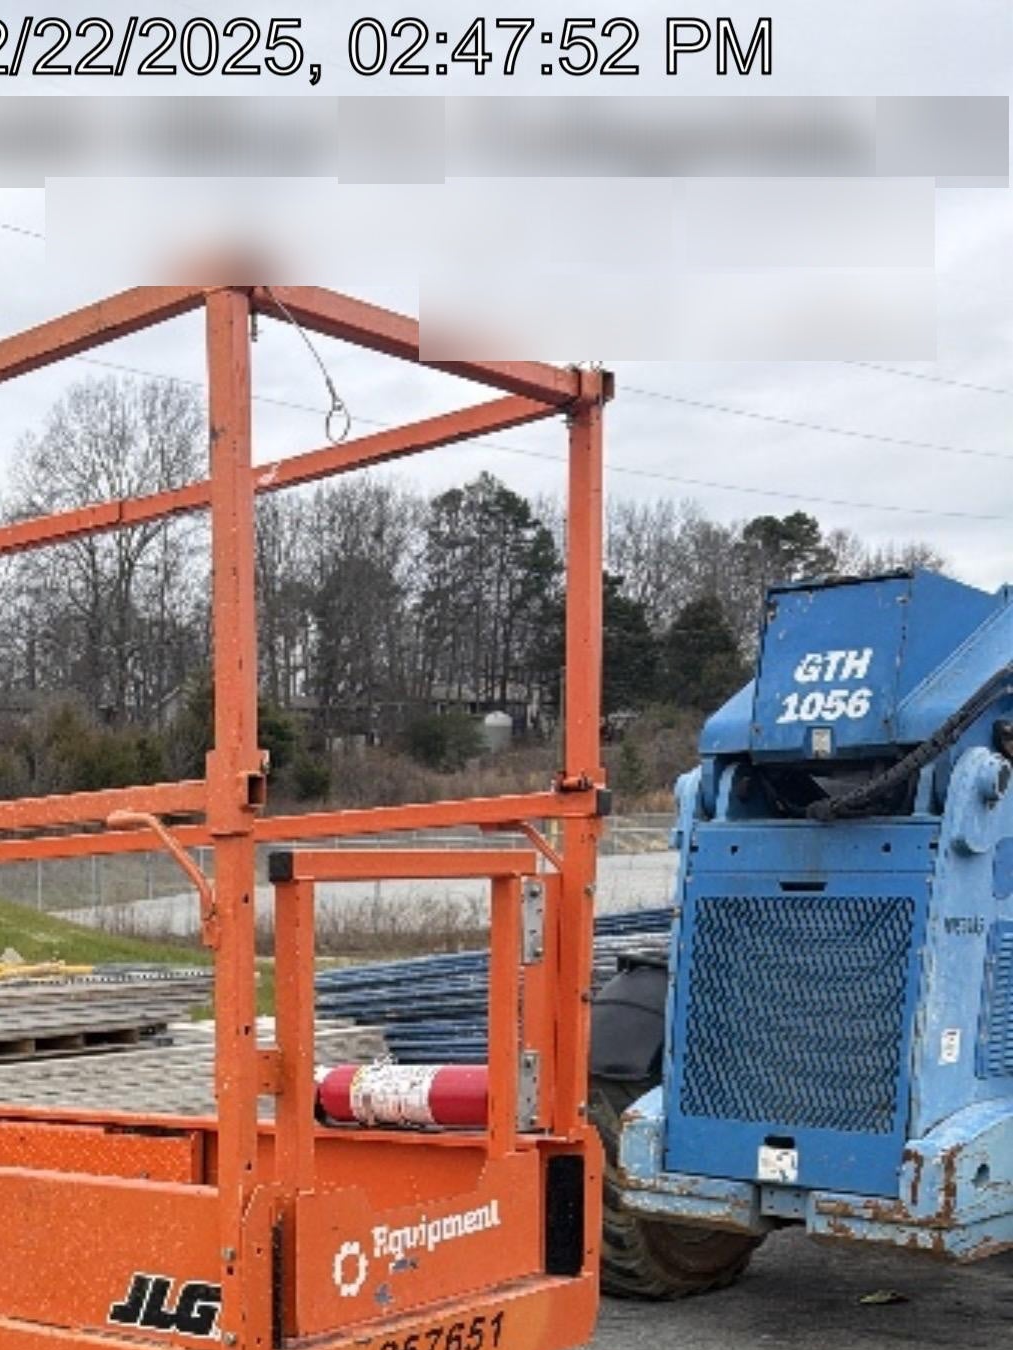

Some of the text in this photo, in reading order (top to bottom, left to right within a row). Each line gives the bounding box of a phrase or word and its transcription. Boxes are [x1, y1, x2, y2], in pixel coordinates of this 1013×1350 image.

[793, 647, 873, 684] GTH
[775, 687, 873, 724] 1056
[107, 1271, 222, 1341] JLG
